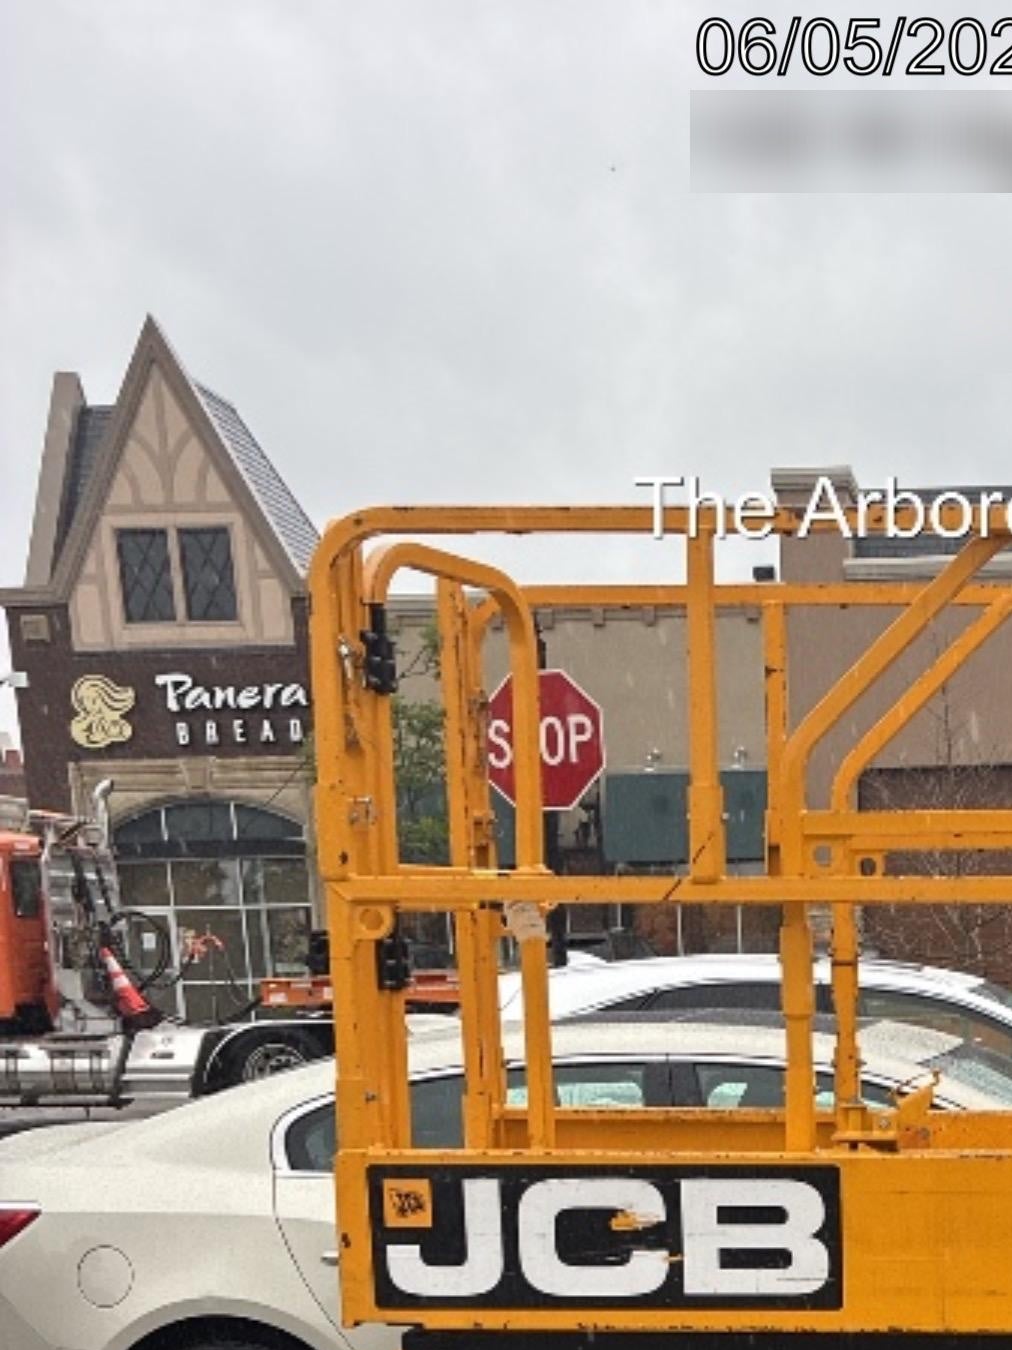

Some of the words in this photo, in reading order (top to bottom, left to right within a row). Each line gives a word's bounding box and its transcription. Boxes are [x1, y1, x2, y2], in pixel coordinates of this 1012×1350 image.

[154, 672, 309, 712] Panera
[175, 718, 303, 746] BREAD
[487, 713, 594, 770] SOP
[386, 1178, 830, 1297] JCB
